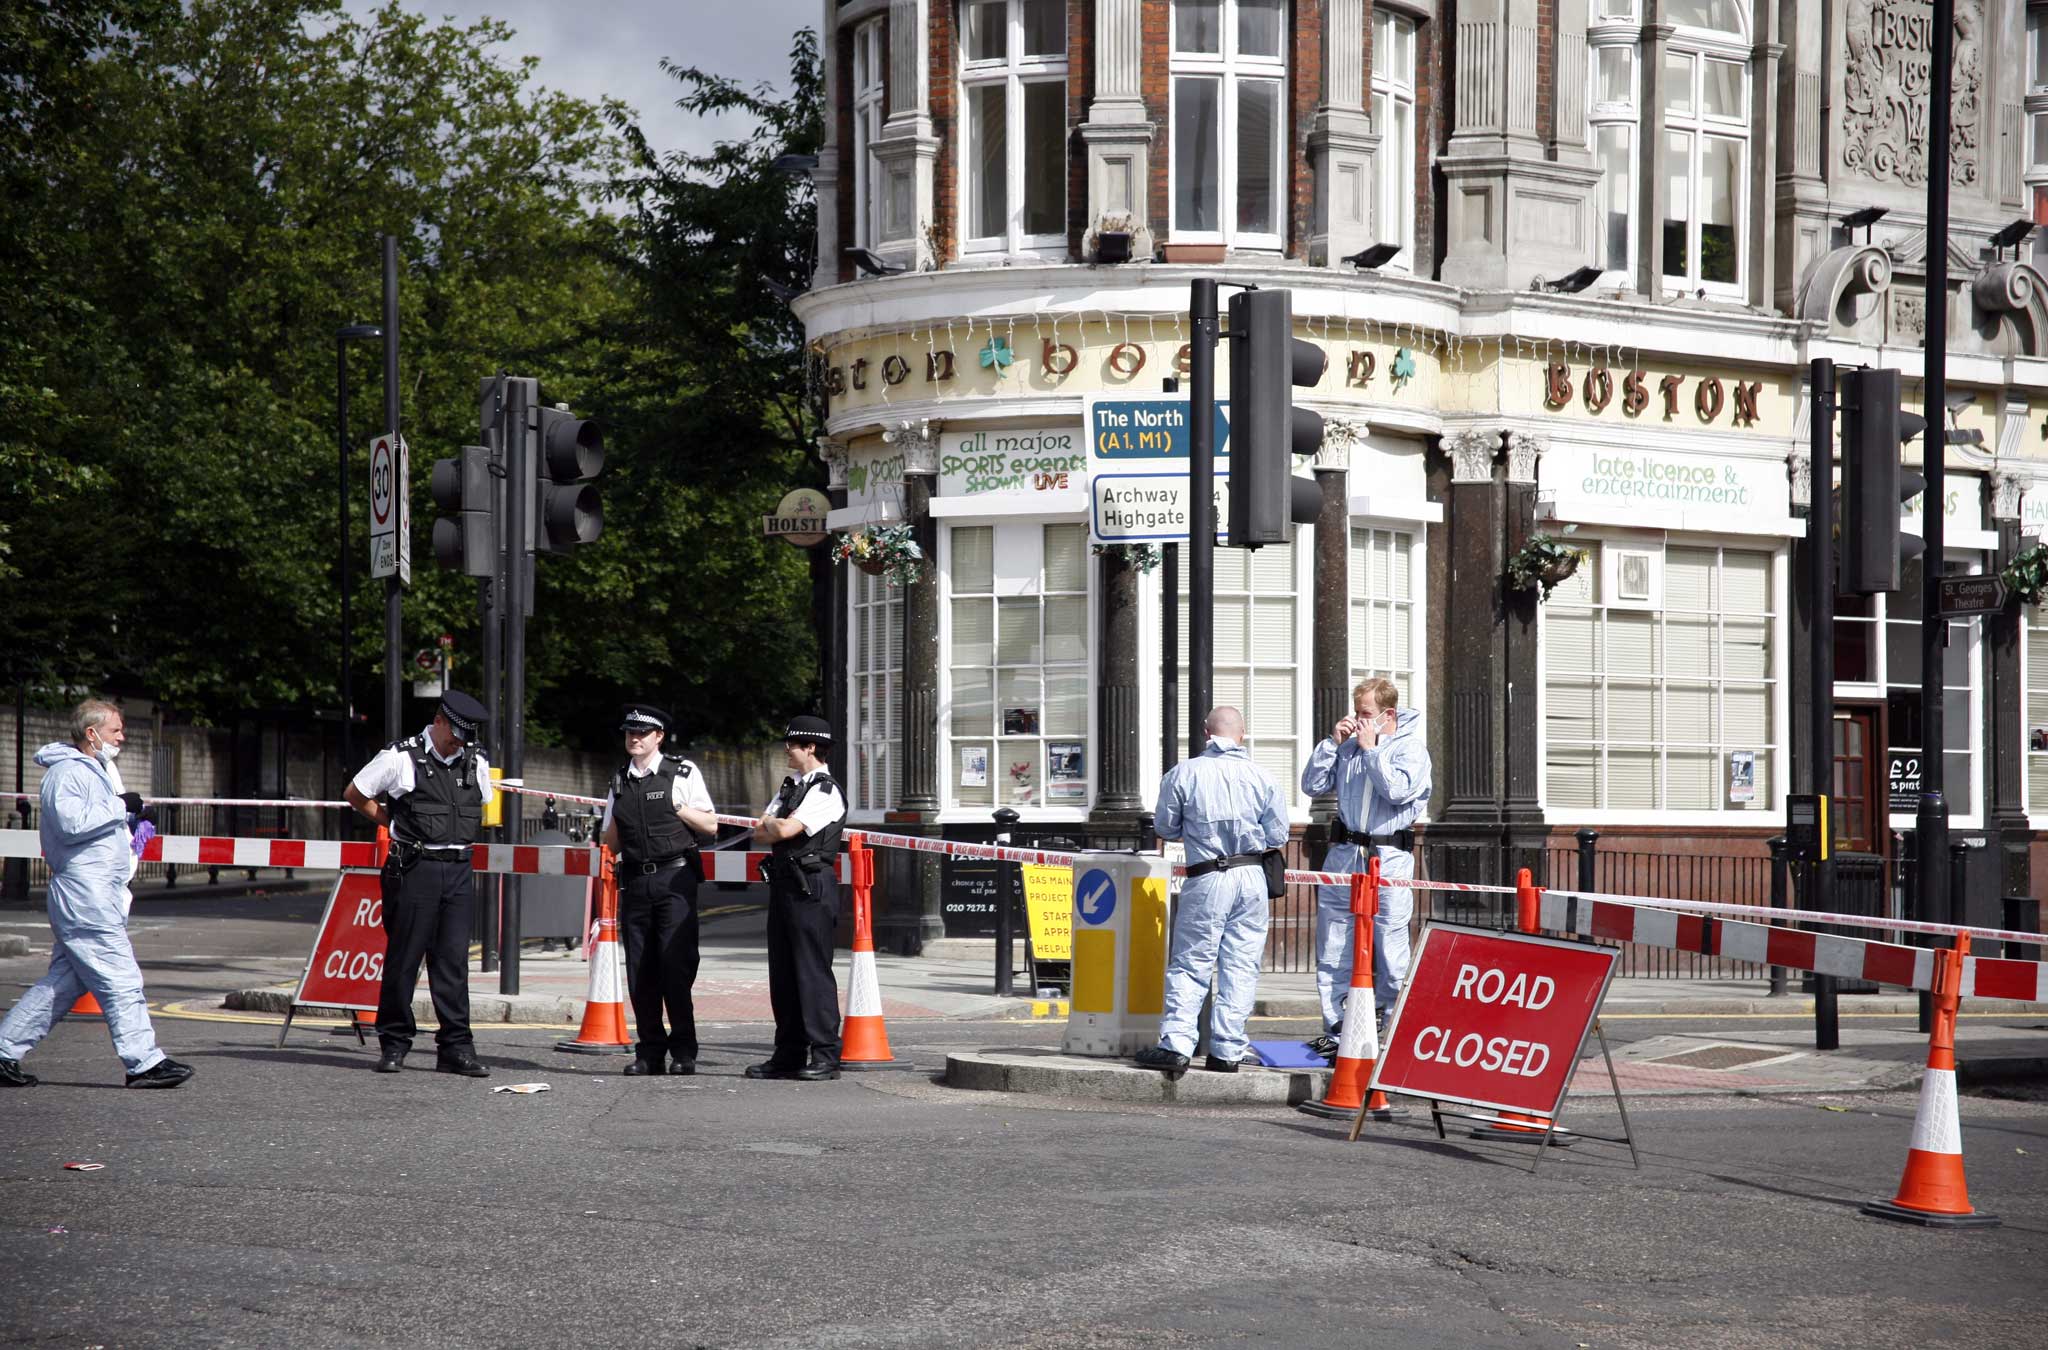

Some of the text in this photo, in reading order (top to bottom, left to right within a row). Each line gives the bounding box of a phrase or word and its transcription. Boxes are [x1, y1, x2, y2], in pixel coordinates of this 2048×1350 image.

[1898, 60, 1931, 94] 189
[1549, 361, 1763, 422] BOSTON
[1097, 408, 1184, 428] The North
[959, 430, 1072, 455] all major
[1139, 431, 1172, 453] M1)
[941, 453, 1007, 477] SPORTS
[374, 463, 390, 500] 30
[965, 473, 1026, 494] SHOWN
[1582, 475, 1749, 506] entertainment
[1103, 488, 1179, 506] Archway
[1104, 509, 1185, 528] Highgate
[380, 553, 394, 569] ENDS
[1959, 583, 1993, 595] Georges
[1889, 758, 1921, 780] £2
[1028, 875, 1047, 885] GAS
[946, 903, 964, 912] 020
[966, 903, 987, 912] 7272
[1029, 893, 1067, 902] PROJECT
[352, 898, 383, 928] RO
[1044, 928, 1071, 937] APPR
[323, 950, 384, 982] CLOS
[1451, 963, 1556, 1011] ROAD
[1412, 1025, 1551, 1078] CLOSED
